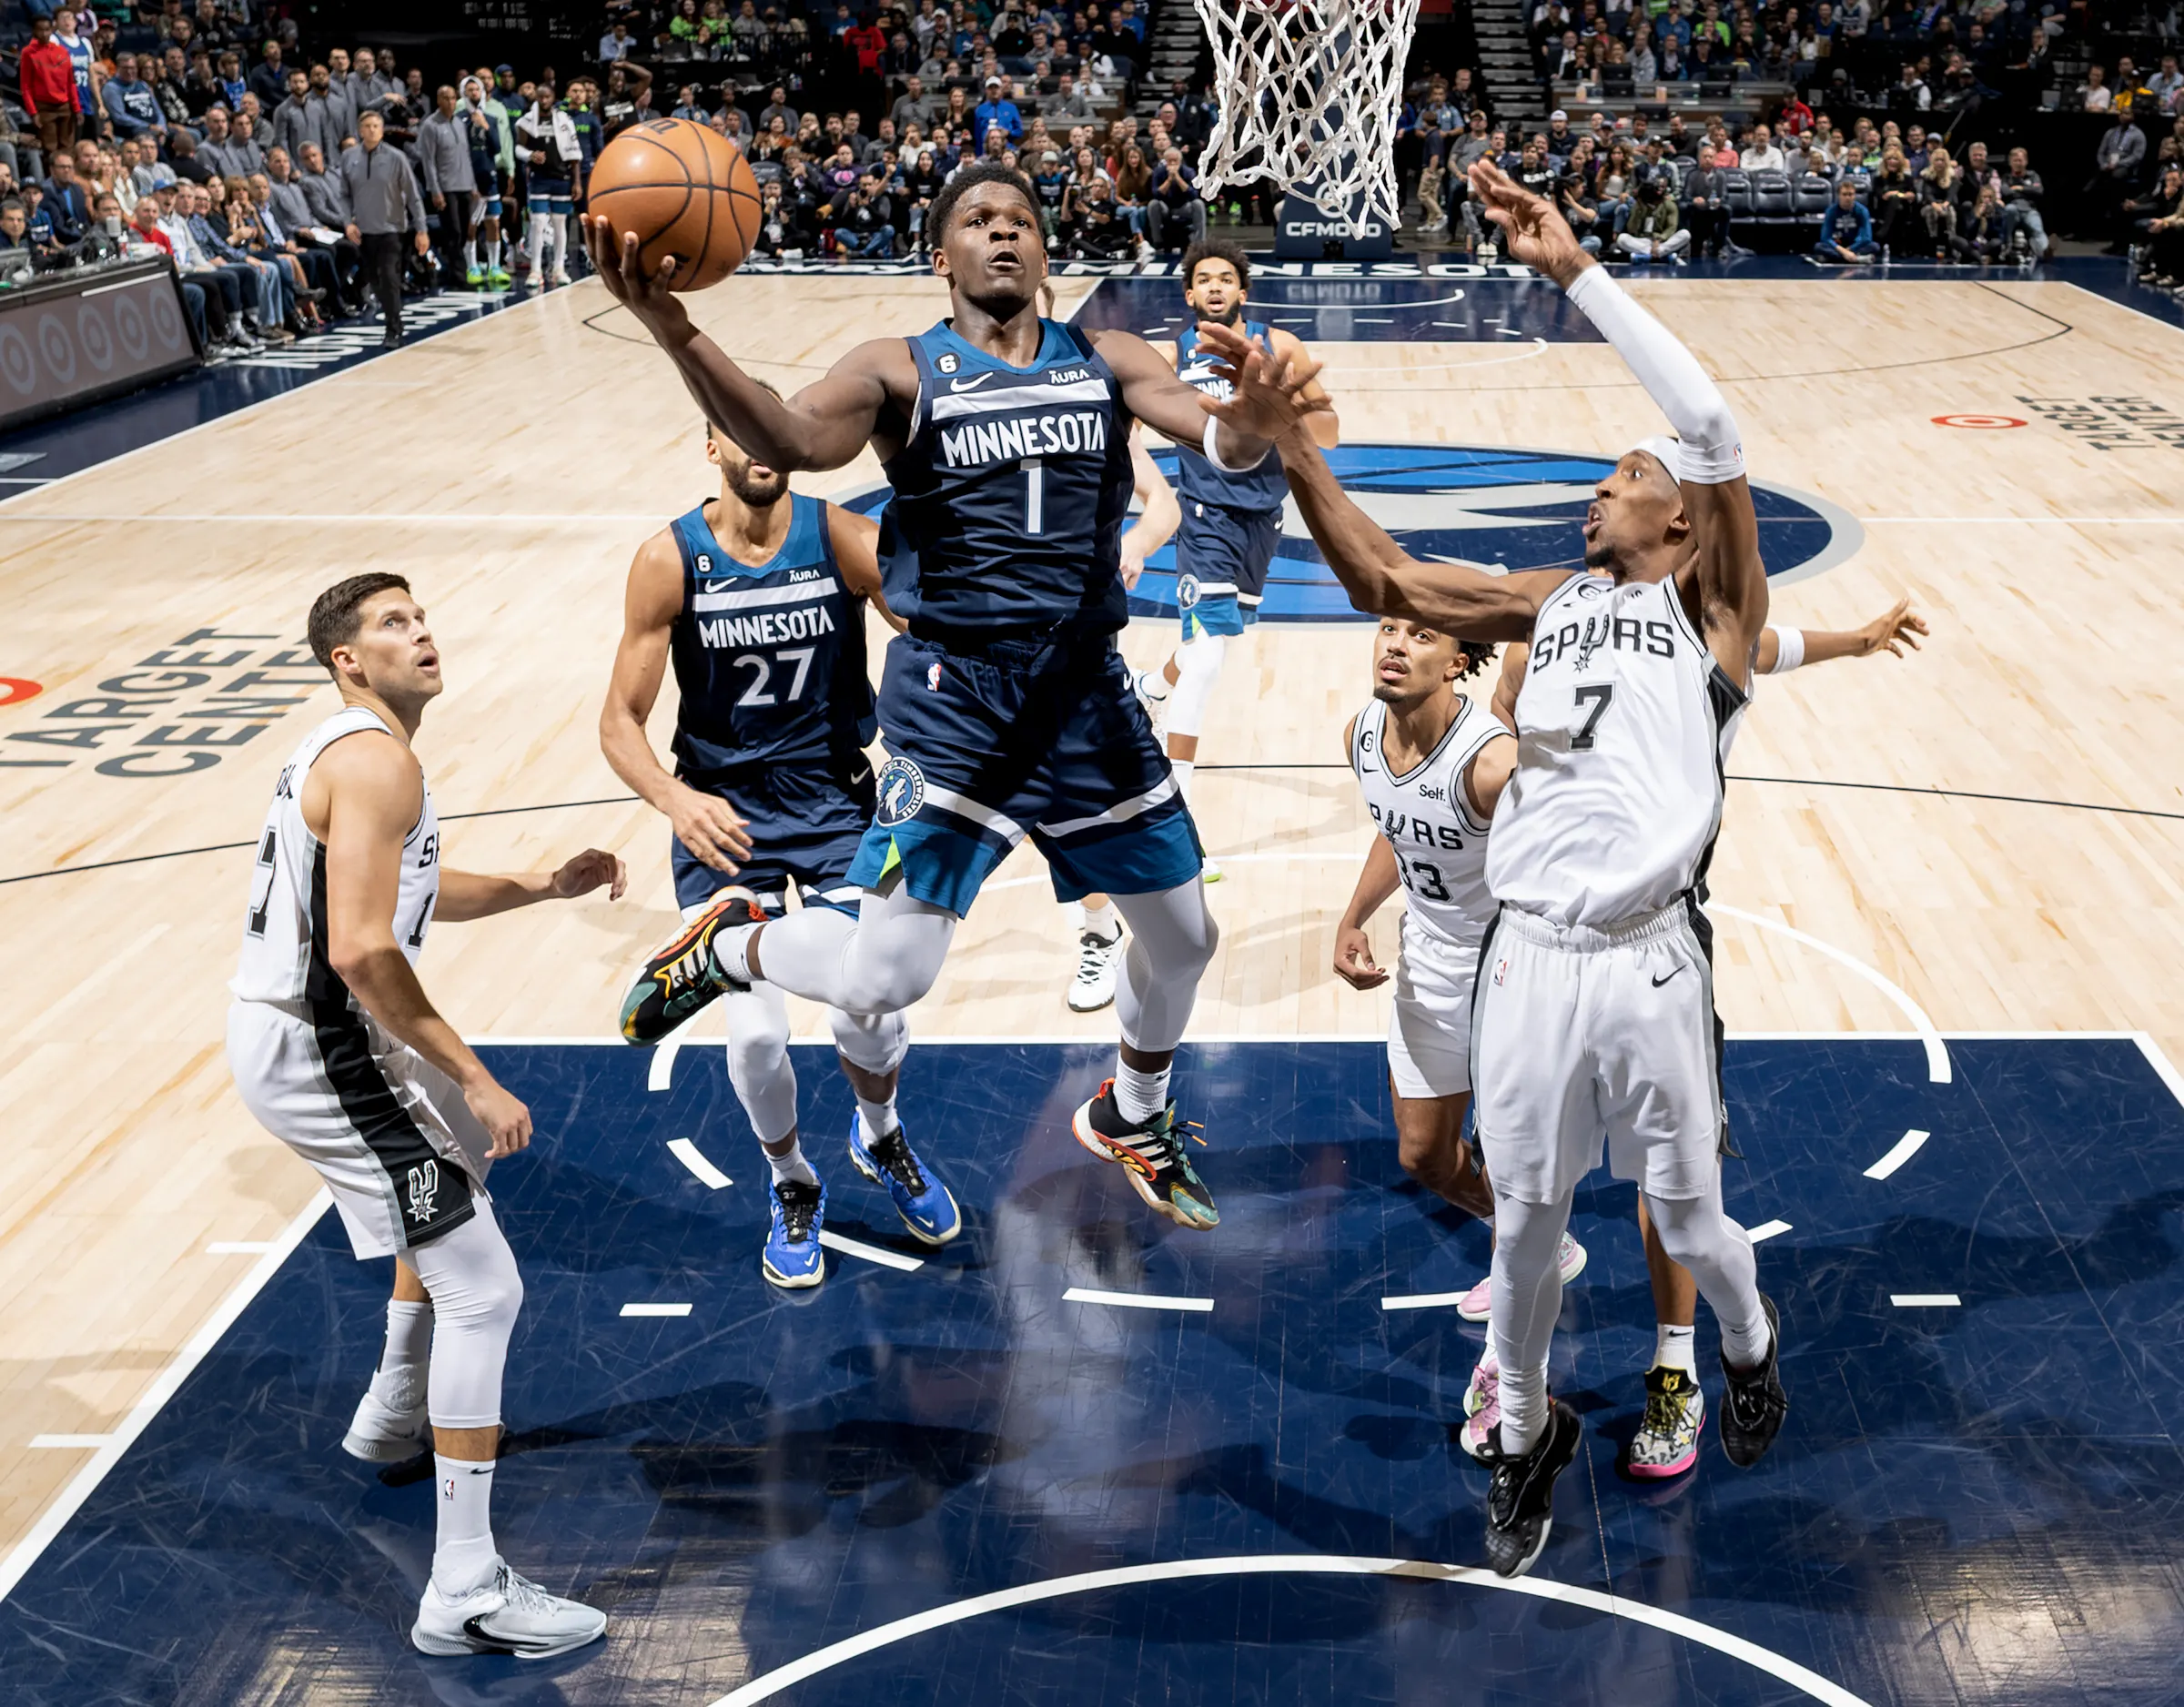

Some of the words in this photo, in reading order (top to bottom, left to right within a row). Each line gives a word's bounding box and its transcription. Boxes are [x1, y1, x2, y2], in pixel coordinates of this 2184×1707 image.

[1285, 221, 1381, 237] CFMOO
[1061, 262, 1549, 277] MINESOT
[940, 354, 956, 373] 6
[941, 412, 1105, 467] MINNESOTA
[2012, 395, 2157, 451] TARGET
[2088, 396, 2184, 449] ENTER
[1020, 459, 1042, 533] 1
[697, 555, 711, 572] 6
[698, 606, 834, 648] MINNESOTA
[1533, 614, 1674, 674] SPURS
[733, 647, 815, 706] 27
[94, 635, 336, 777] CENTE
[1570, 683, 1616, 751] 7
[1419, 784, 1446, 802] Self.
[1370, 803, 1463, 850] PURS
